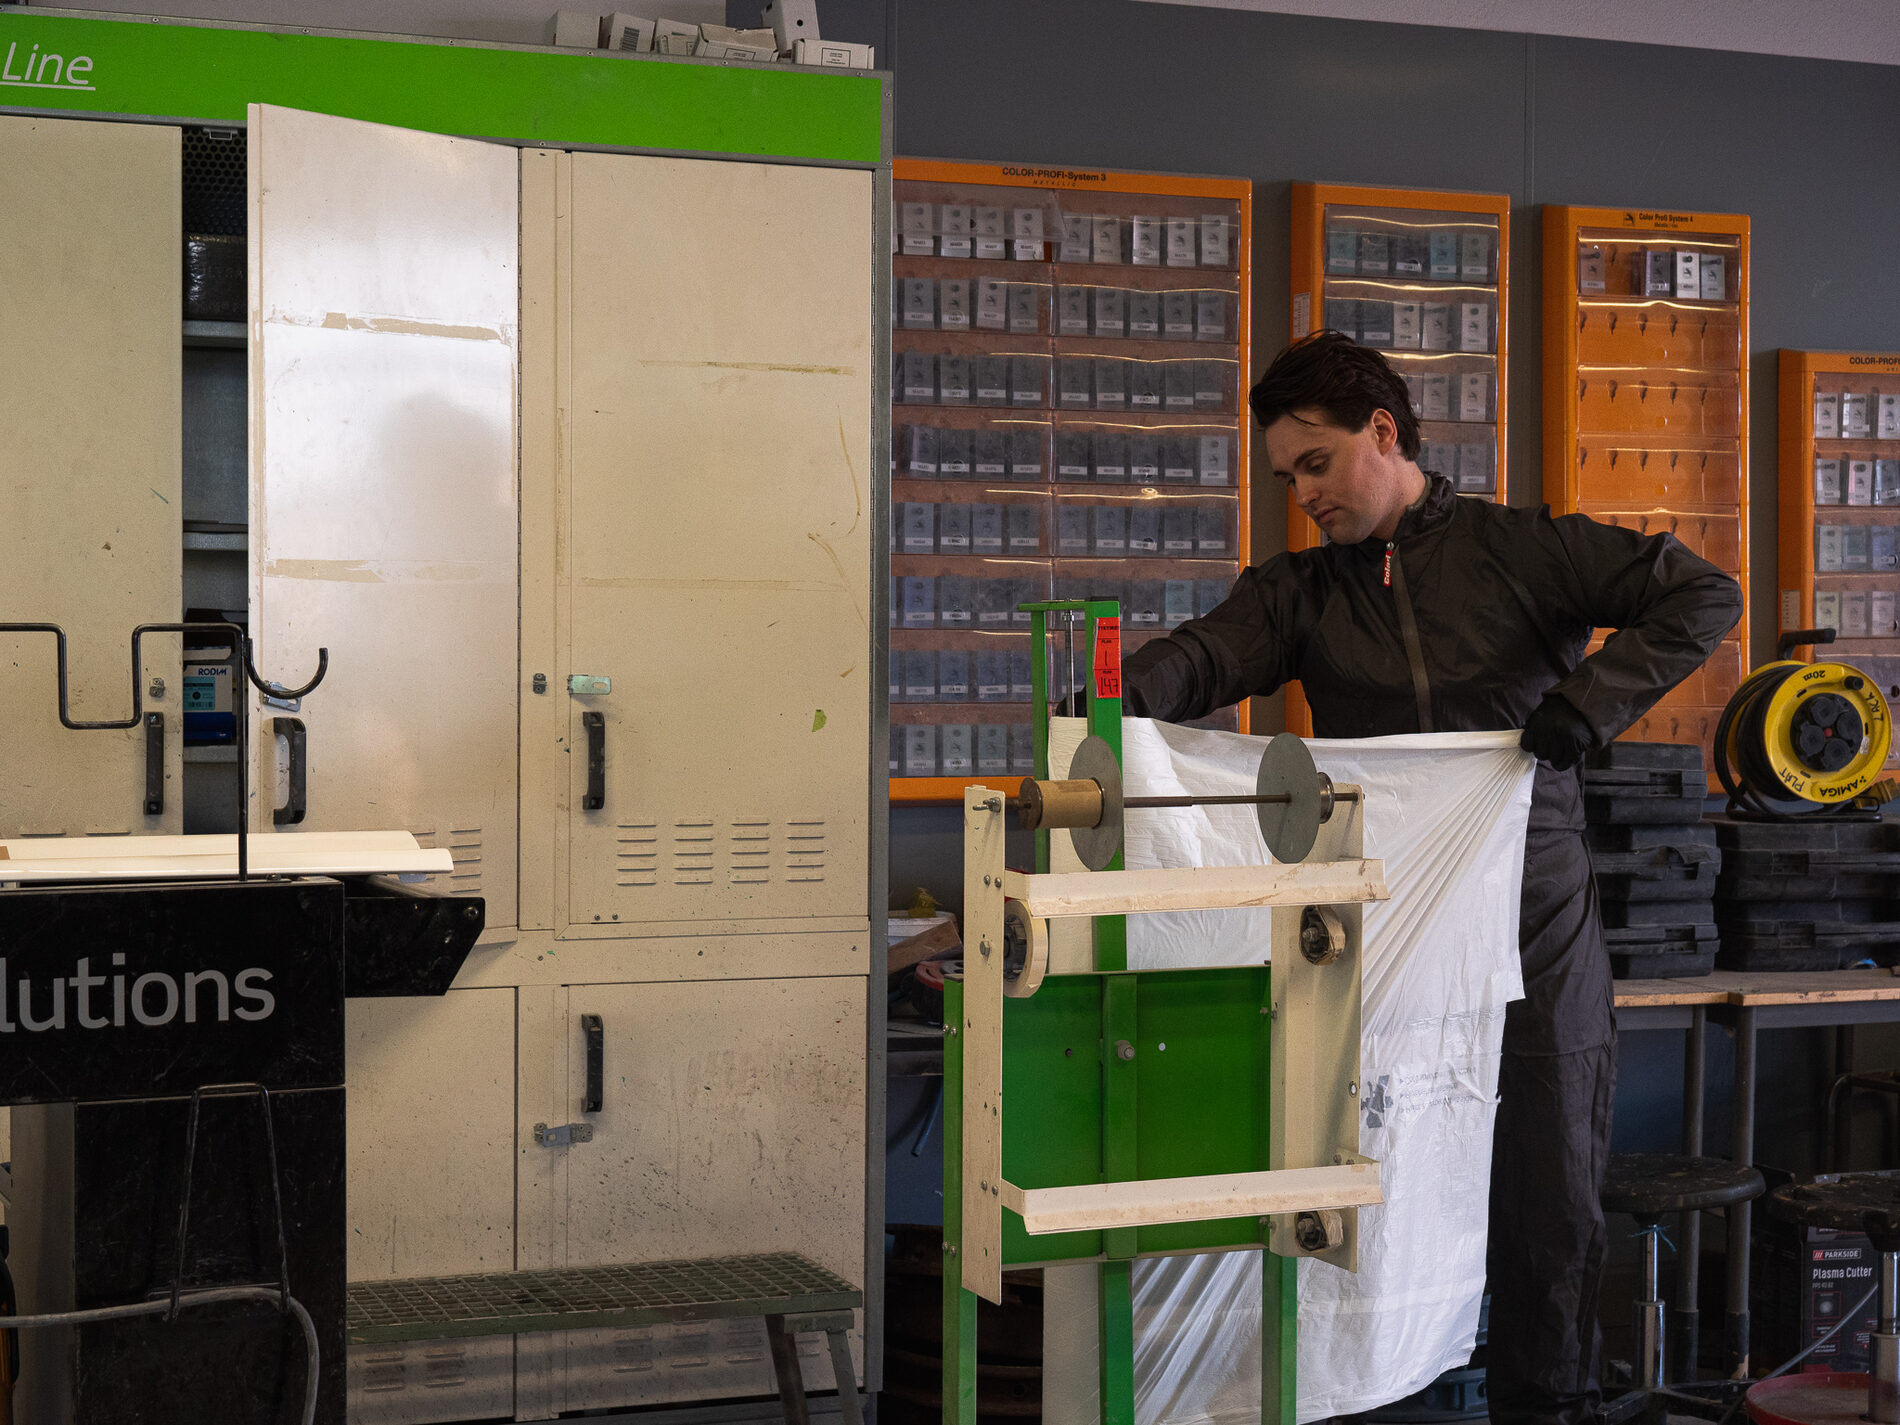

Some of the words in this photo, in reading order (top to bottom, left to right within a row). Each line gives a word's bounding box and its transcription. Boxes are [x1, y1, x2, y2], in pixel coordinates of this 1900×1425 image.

[1, 41, 94, 85] Line
[1002, 166, 1099, 182] COLOR-PROFI-System
[1100, 173, 1107, 182] 3
[198, 667, 227, 676] RODIM
[1802, 669, 1826, 682] 20m
[1819, 781, 1859, 798] AMIGA
[1824, 1249, 1859, 1259] PARKSIDE
[1812, 1268, 1845, 1279] Plasma
[1846, 1266, 1873, 1278] Cutter
